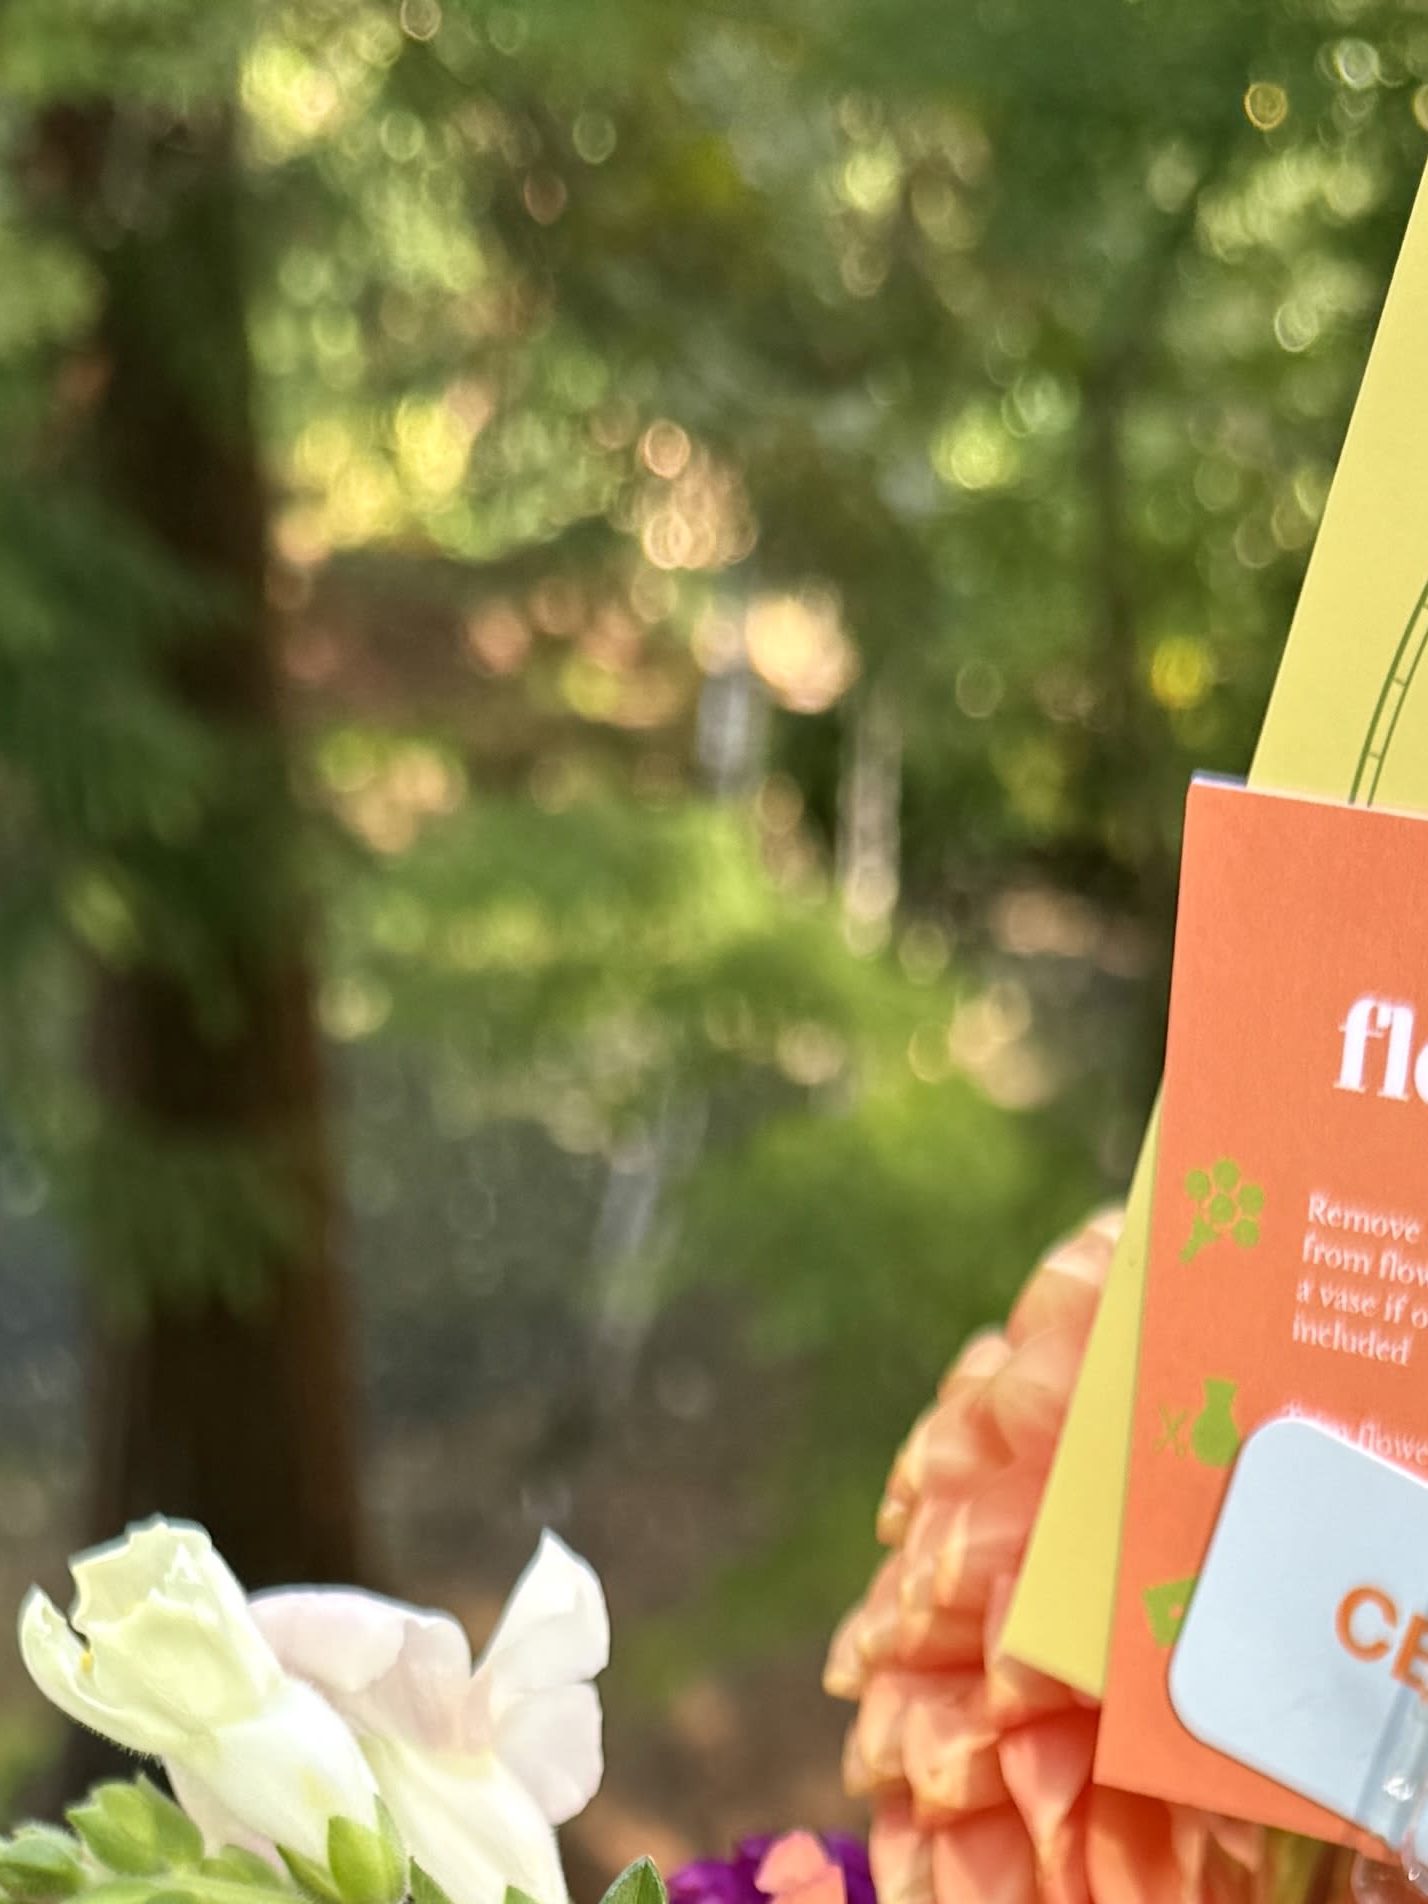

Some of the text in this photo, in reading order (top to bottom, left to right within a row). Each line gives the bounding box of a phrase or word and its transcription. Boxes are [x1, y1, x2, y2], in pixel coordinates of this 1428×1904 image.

[1308, 1191, 1420, 1245] Remove
[1302, 1231, 1371, 1275] from
[1296, 1281, 1310, 1304] a
[1319, 1284, 1377, 1317] vase
[1384, 1293, 1408, 1324] if
[1292, 1311, 1410, 1366] included
